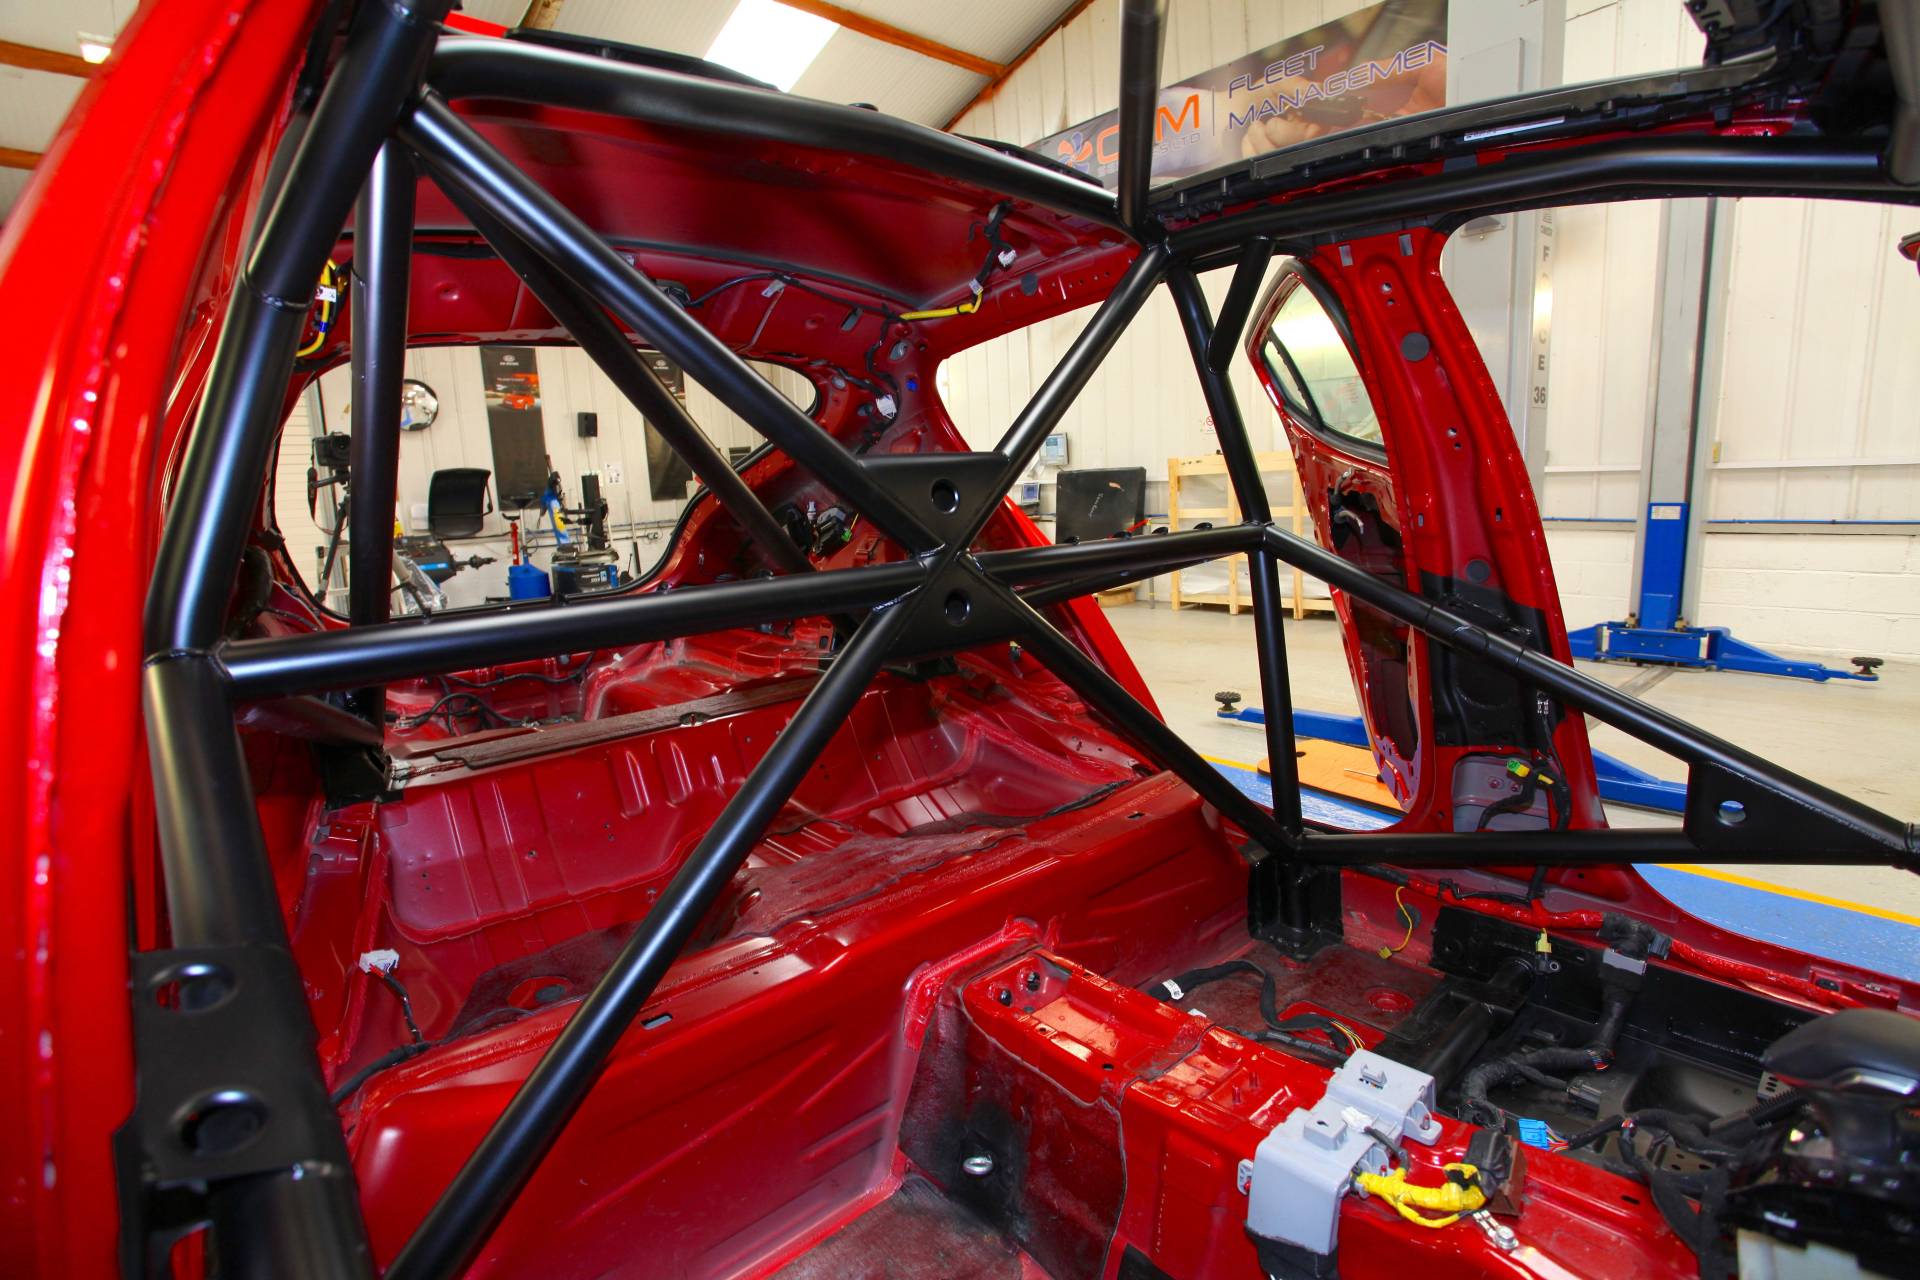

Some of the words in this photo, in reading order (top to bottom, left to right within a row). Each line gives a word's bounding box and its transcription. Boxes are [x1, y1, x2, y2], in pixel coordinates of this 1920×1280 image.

[1228, 44, 1325, 100] FLEET
[1228, 39, 1448, 130] MANAGEMEN
[1096, 93, 1200, 165] CM
[1533, 385, 1547, 405] 36
